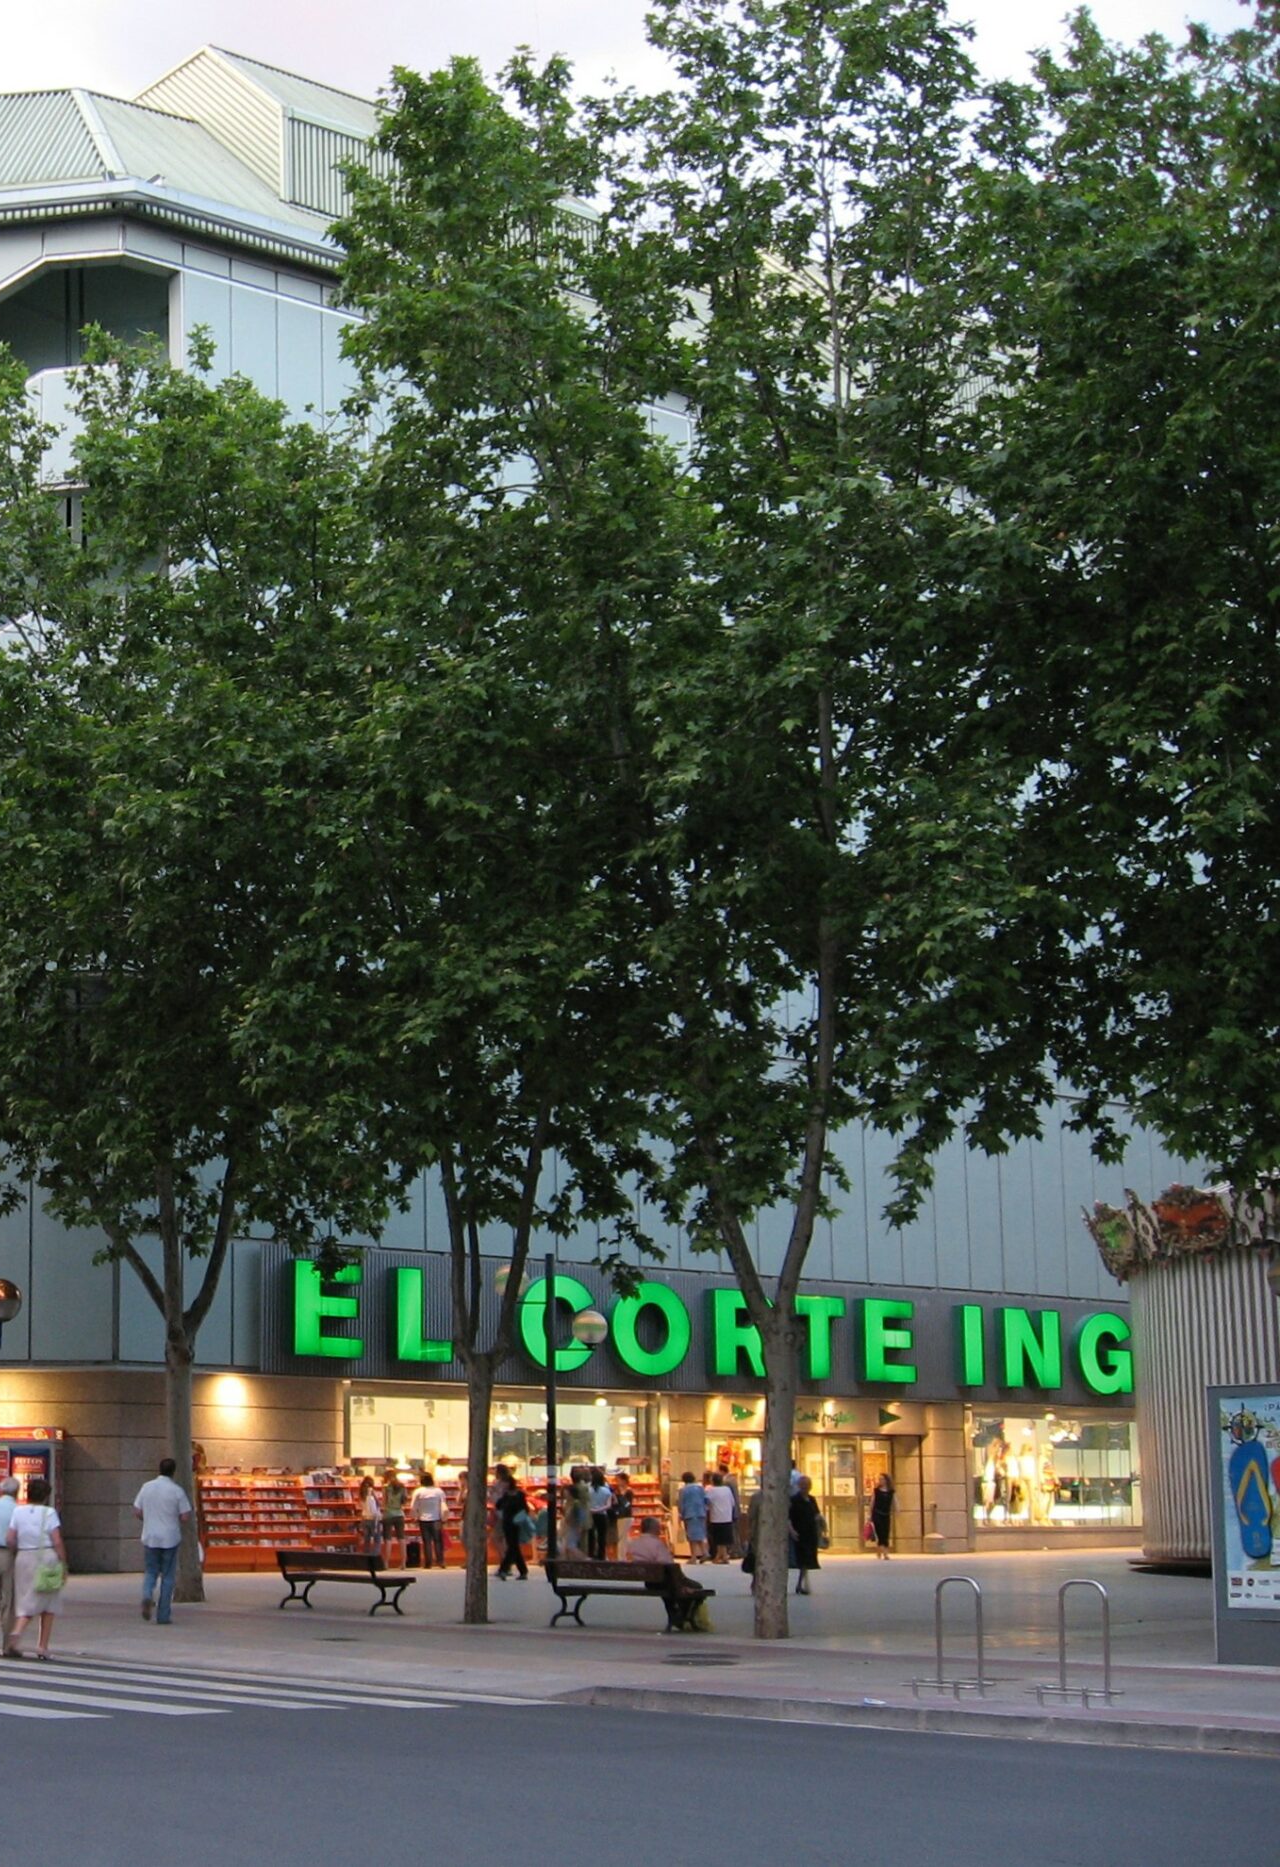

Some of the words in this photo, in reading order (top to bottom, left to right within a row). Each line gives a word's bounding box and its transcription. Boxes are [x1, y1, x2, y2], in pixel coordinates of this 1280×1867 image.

[292, 1257, 455, 1365] EL
[518, 1272, 919, 1385] CORTE
[960, 1302, 1135, 1397] ING
